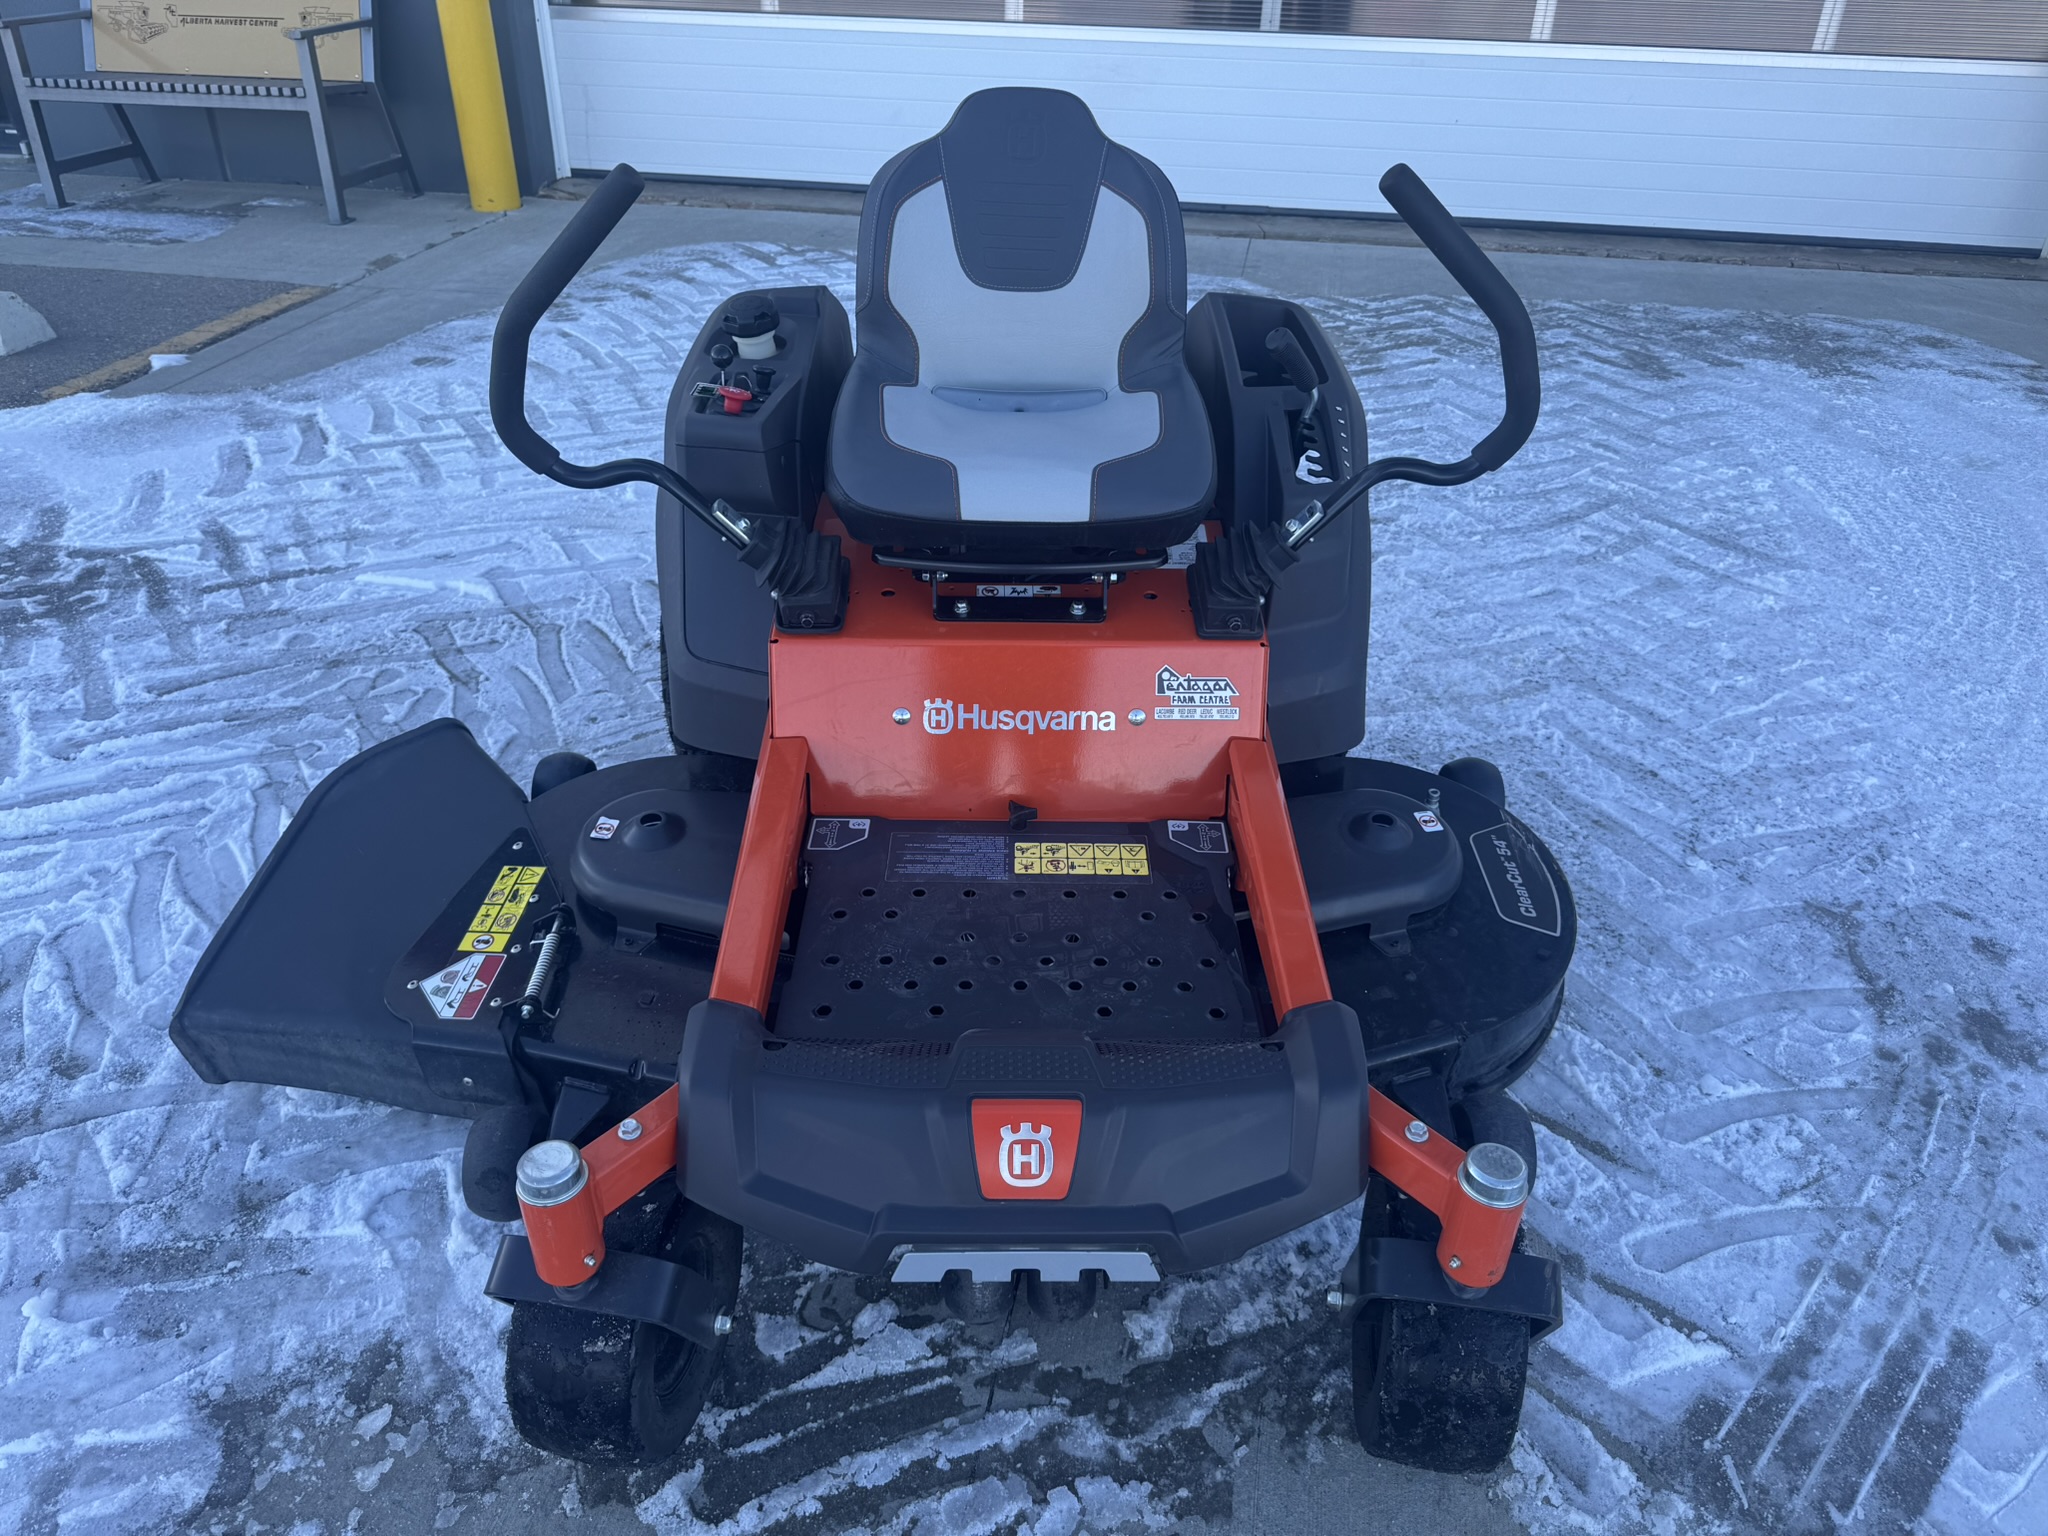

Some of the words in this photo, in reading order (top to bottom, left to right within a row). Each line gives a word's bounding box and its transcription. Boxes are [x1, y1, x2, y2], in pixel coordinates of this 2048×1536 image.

[180, 17, 212, 27] ALBERTA
[214, 18, 248, 26] HARVEST
[249, 19, 278, 27] CENTRE
[1172, 695, 1196, 704] FARM
[957, 703, 1116, 735] Husqvarna
